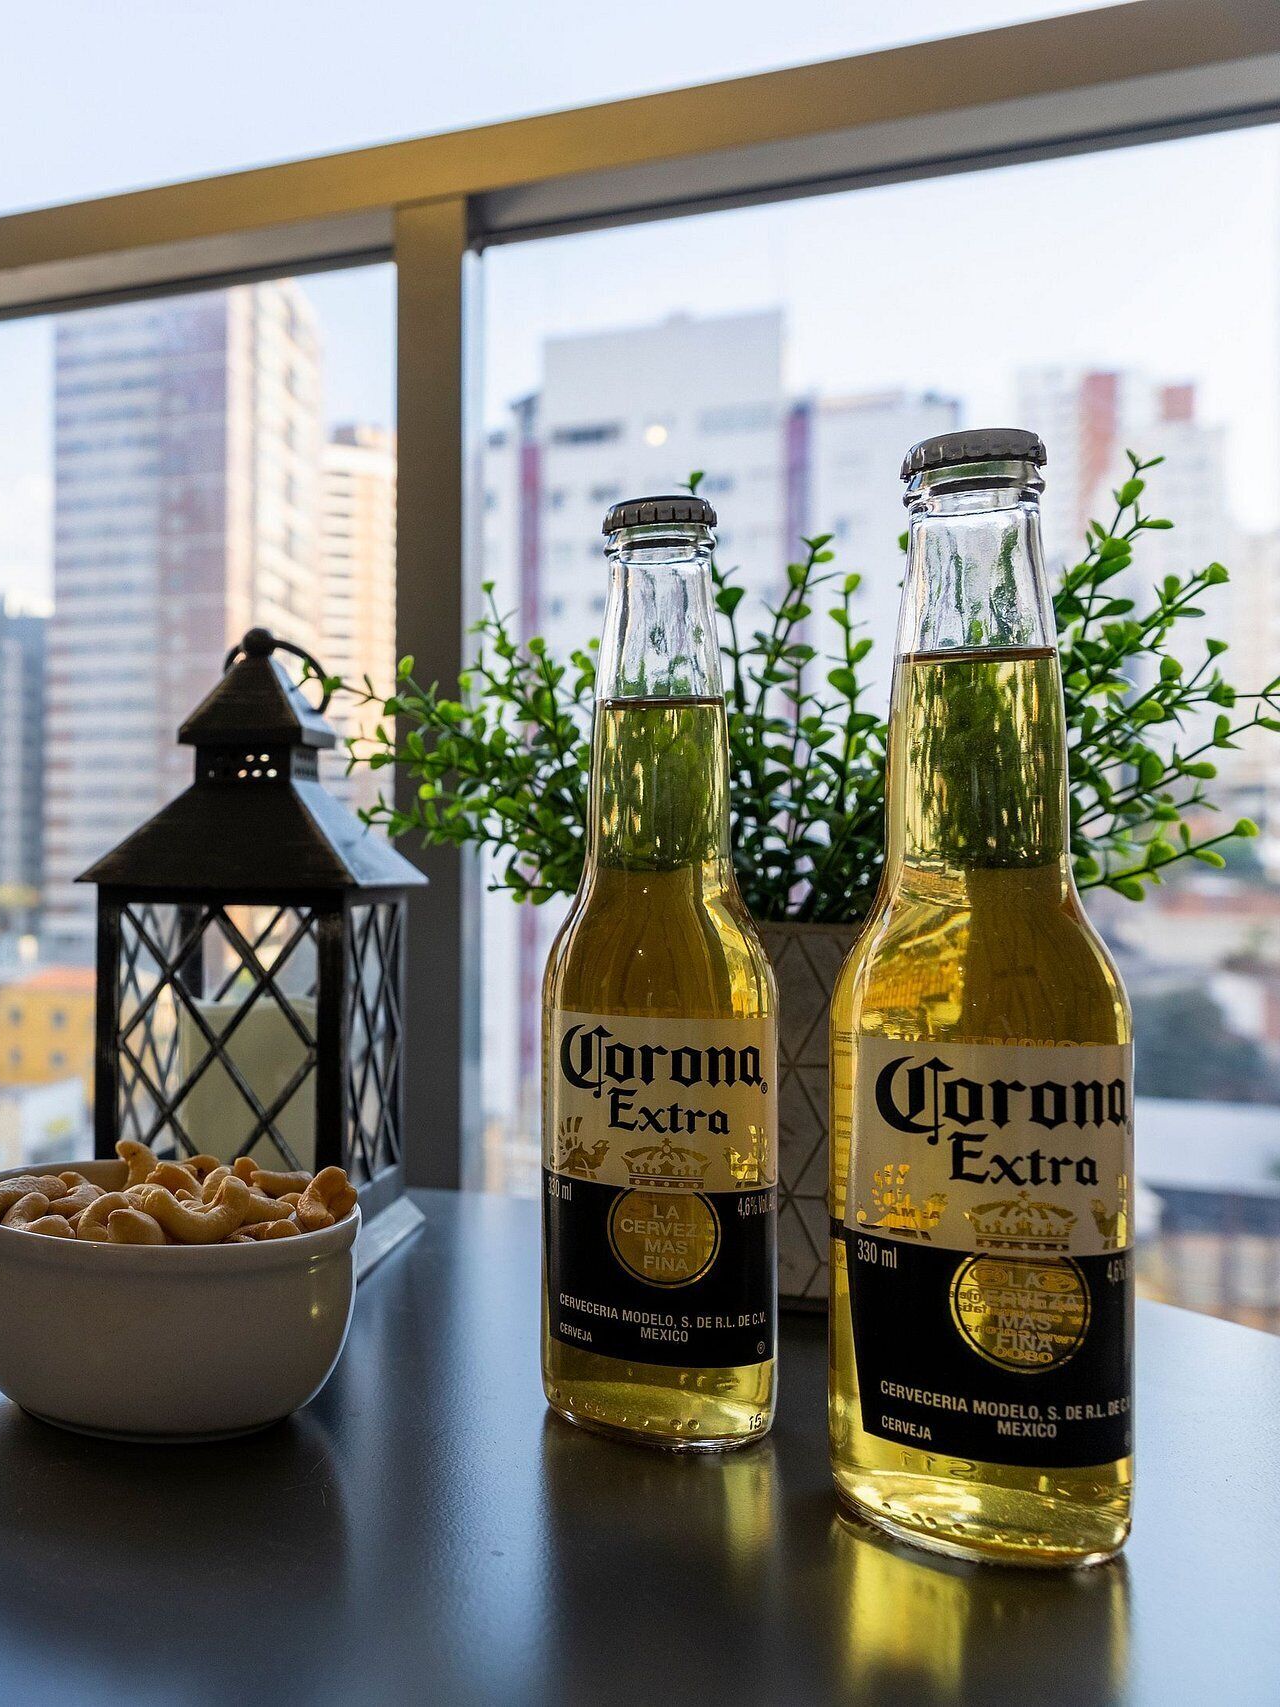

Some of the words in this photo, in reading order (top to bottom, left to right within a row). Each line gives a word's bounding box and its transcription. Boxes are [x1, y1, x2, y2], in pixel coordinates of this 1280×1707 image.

[560, 1024, 764, 1098] Corona
[607, 1087, 730, 1135] Extra
[875, 1055, 1128, 1145] Corona
[947, 1131, 1099, 1186] Extra
[561, 1182, 572, 1202] ml
[653, 1204, 680, 1220] LA
[644, 1238, 689, 1255] MAS
[857, 1238, 877, 1264] 330
[881, 1242, 897, 1269] ml
[643, 1255, 689, 1272] FINA
[560, 1292, 618, 1320] CERVECERIA
[622, 1309, 677, 1329] MODELO,
[681, 1316, 693, 1328] S.
[697, 1316, 712, 1329] DE
[715, 1314, 736, 1328] R.L.
[738, 1313, 750, 1327] DE
[752, 1311, 766, 1326] C.V.
[559, 1321, 593, 1343] CERVEJA
[998, 1313, 1052, 1331] MAS
[640, 1326, 689, 1343] MEXICO
[996, 1331, 1054, 1352] FINA
[880, 1380, 968, 1413] CERVECERIA
[973, 1400, 1044, 1422] MODELO,
[1047, 1406, 1061, 1421] S.
[1065, 1405, 1083, 1420] DE
[1085, 1403, 1106, 1420] R.L.
[1107, 1399, 1120, 1416] DE
[881, 1415, 932, 1441] CERVEJA
[997, 1420, 1057, 1438] MEXICO
